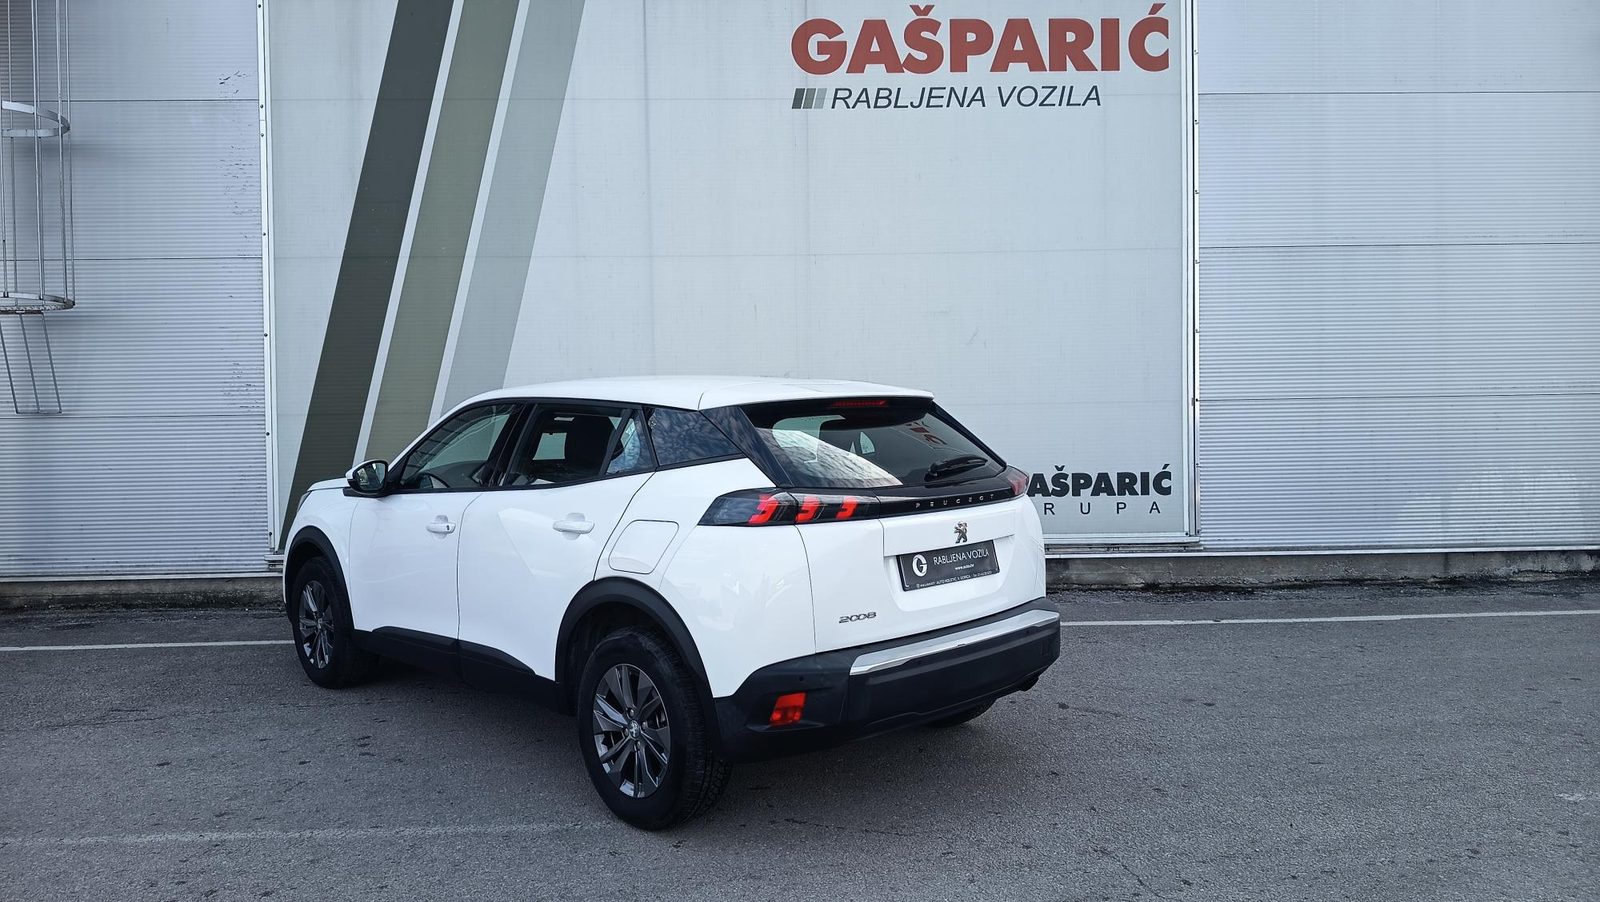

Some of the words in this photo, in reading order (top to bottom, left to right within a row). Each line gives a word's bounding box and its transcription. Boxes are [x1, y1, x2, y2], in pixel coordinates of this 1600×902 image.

[791, 3, 1170, 75] GAŠPARIĆ
[831, 86, 986, 109] RABLJENA
[997, 85, 1102, 108] VOZILA
[1027, 464, 1172, 497] AŠPARIĆ
[915, 494, 994, 508] PEUGEOT
[1044, 501, 1161, 515] RUPA
[933, 552, 967, 565] RABLJENA
[966, 548, 990, 560] VOZILA
[839, 611, 877, 623] 2008
